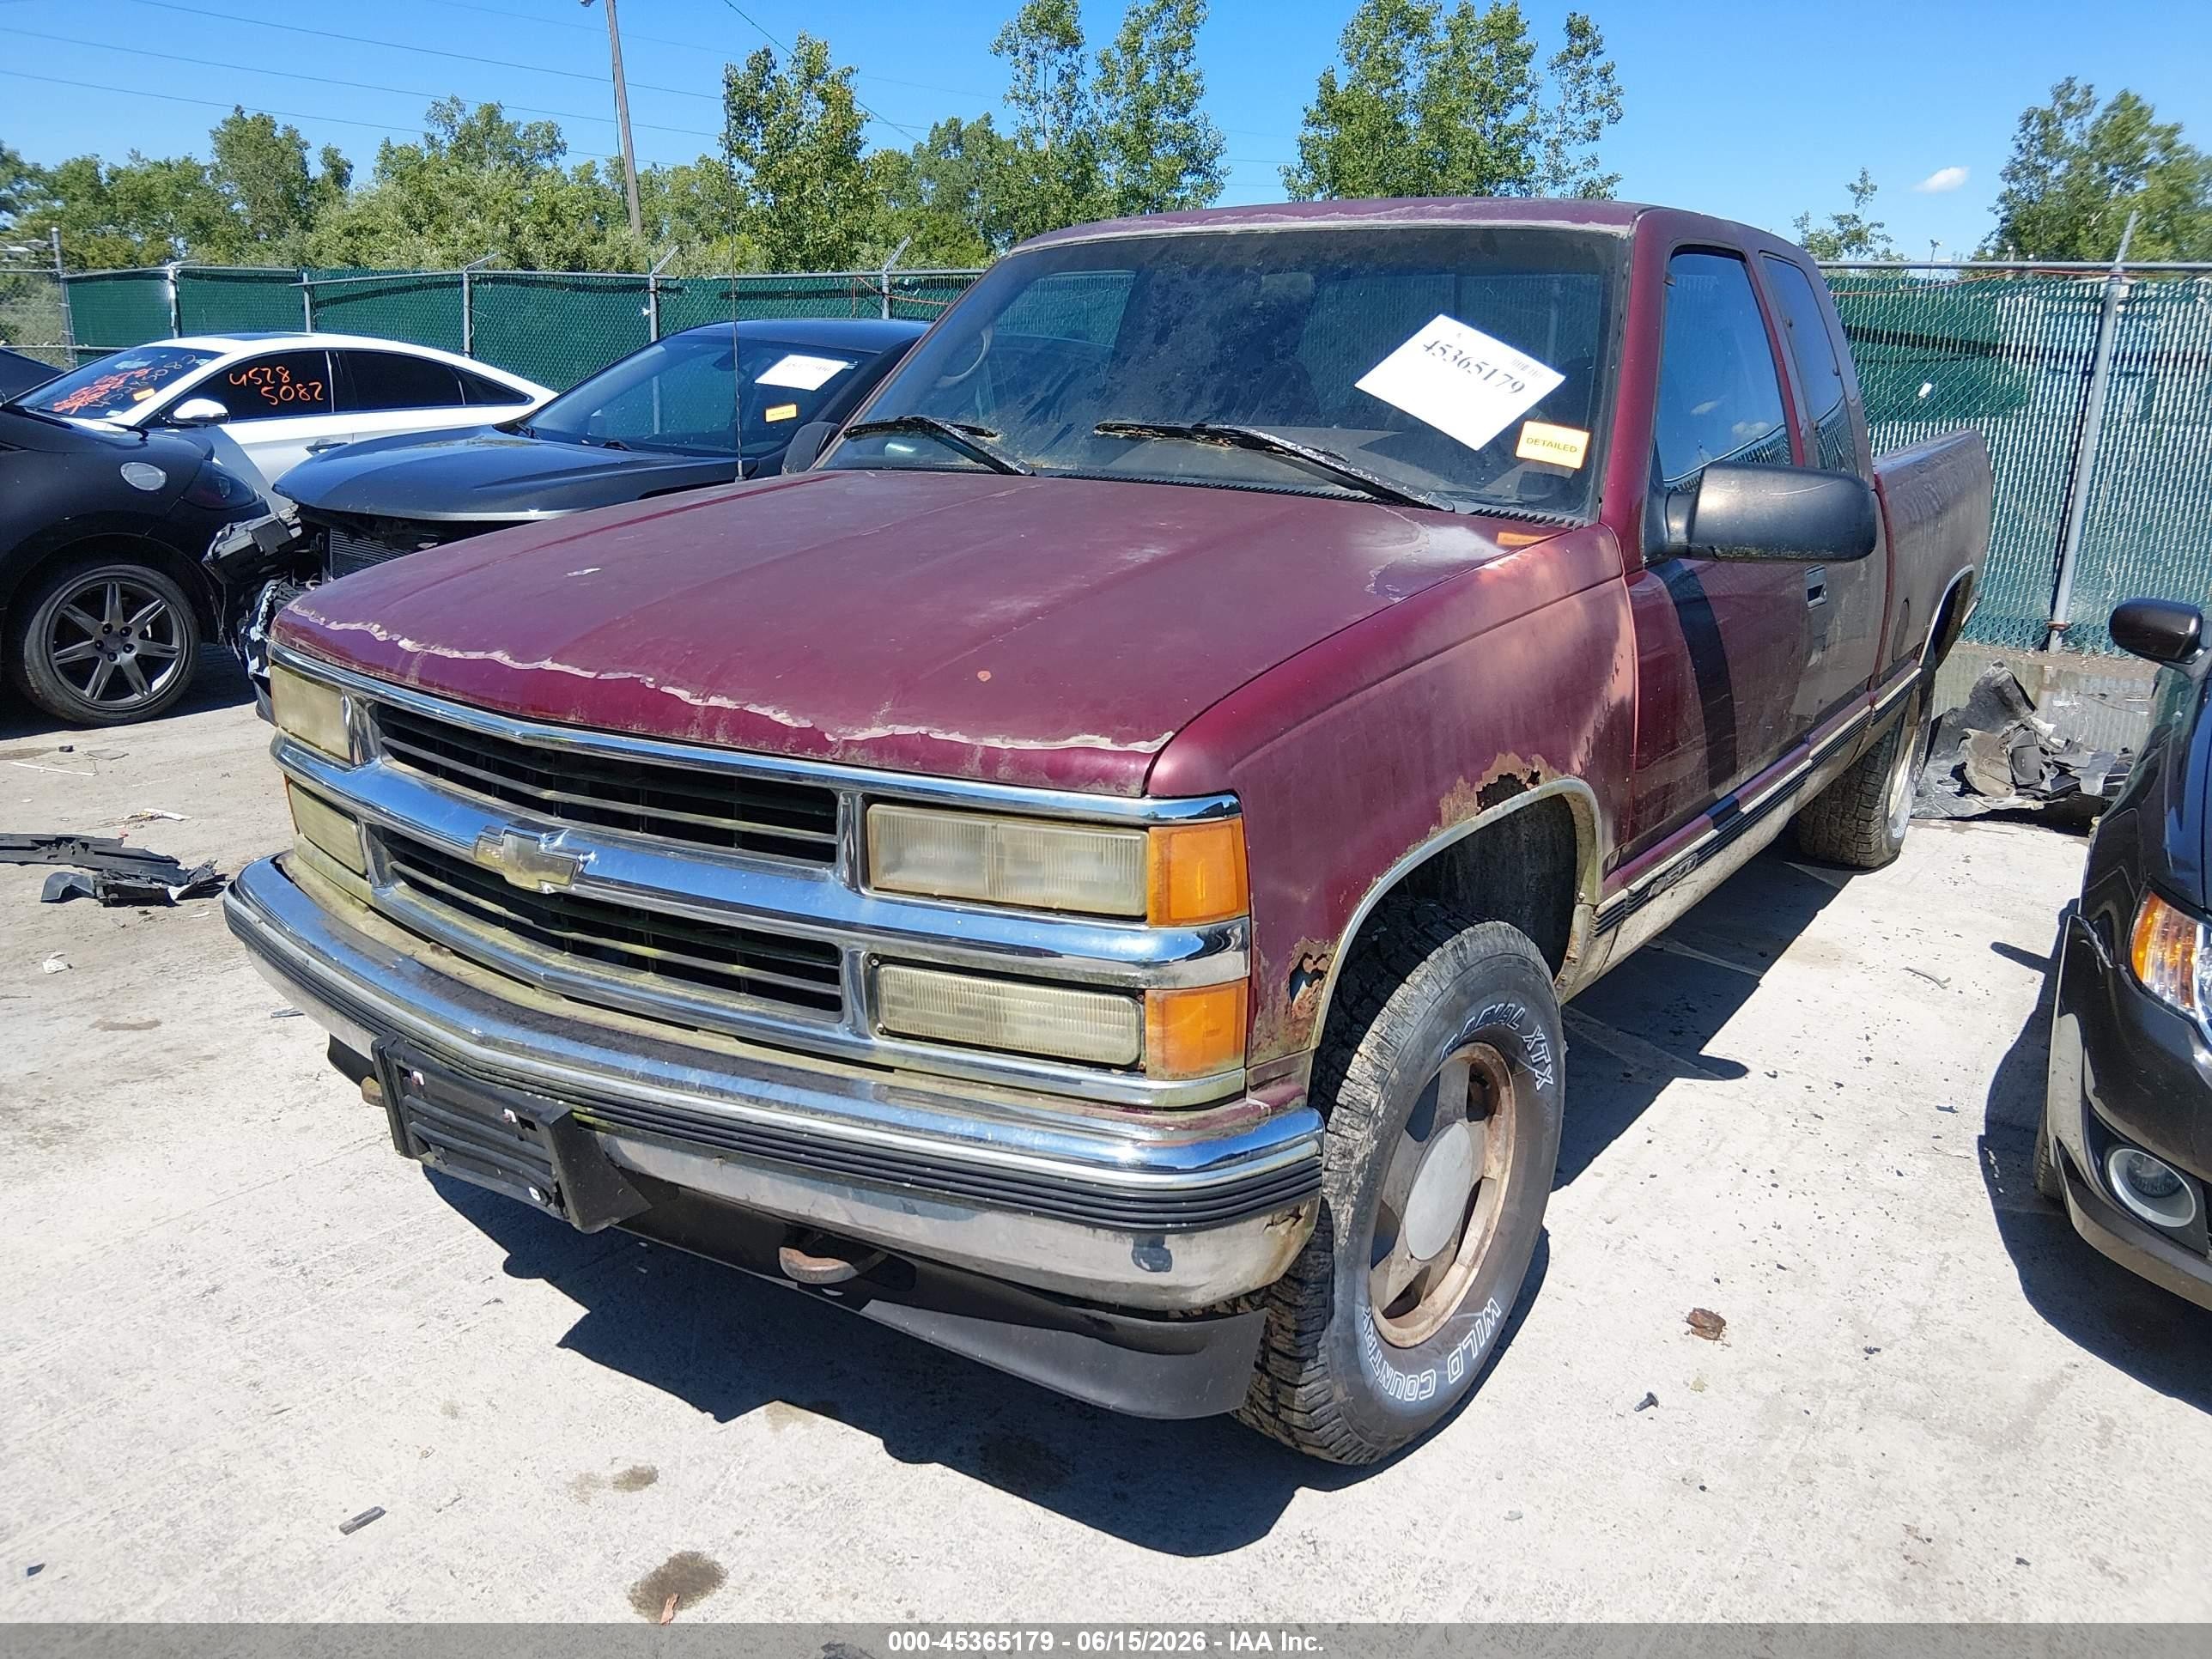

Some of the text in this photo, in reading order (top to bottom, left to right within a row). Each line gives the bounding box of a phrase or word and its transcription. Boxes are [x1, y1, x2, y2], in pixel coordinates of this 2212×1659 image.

[261, 382, 325, 405] 5082
[1423, 339, 1527, 395] 45365179
[1526, 436, 1578, 453] DETAILED
[1522, 1024, 1555, 1092] XTX
[1447, 1297, 1503, 1385] WILD
